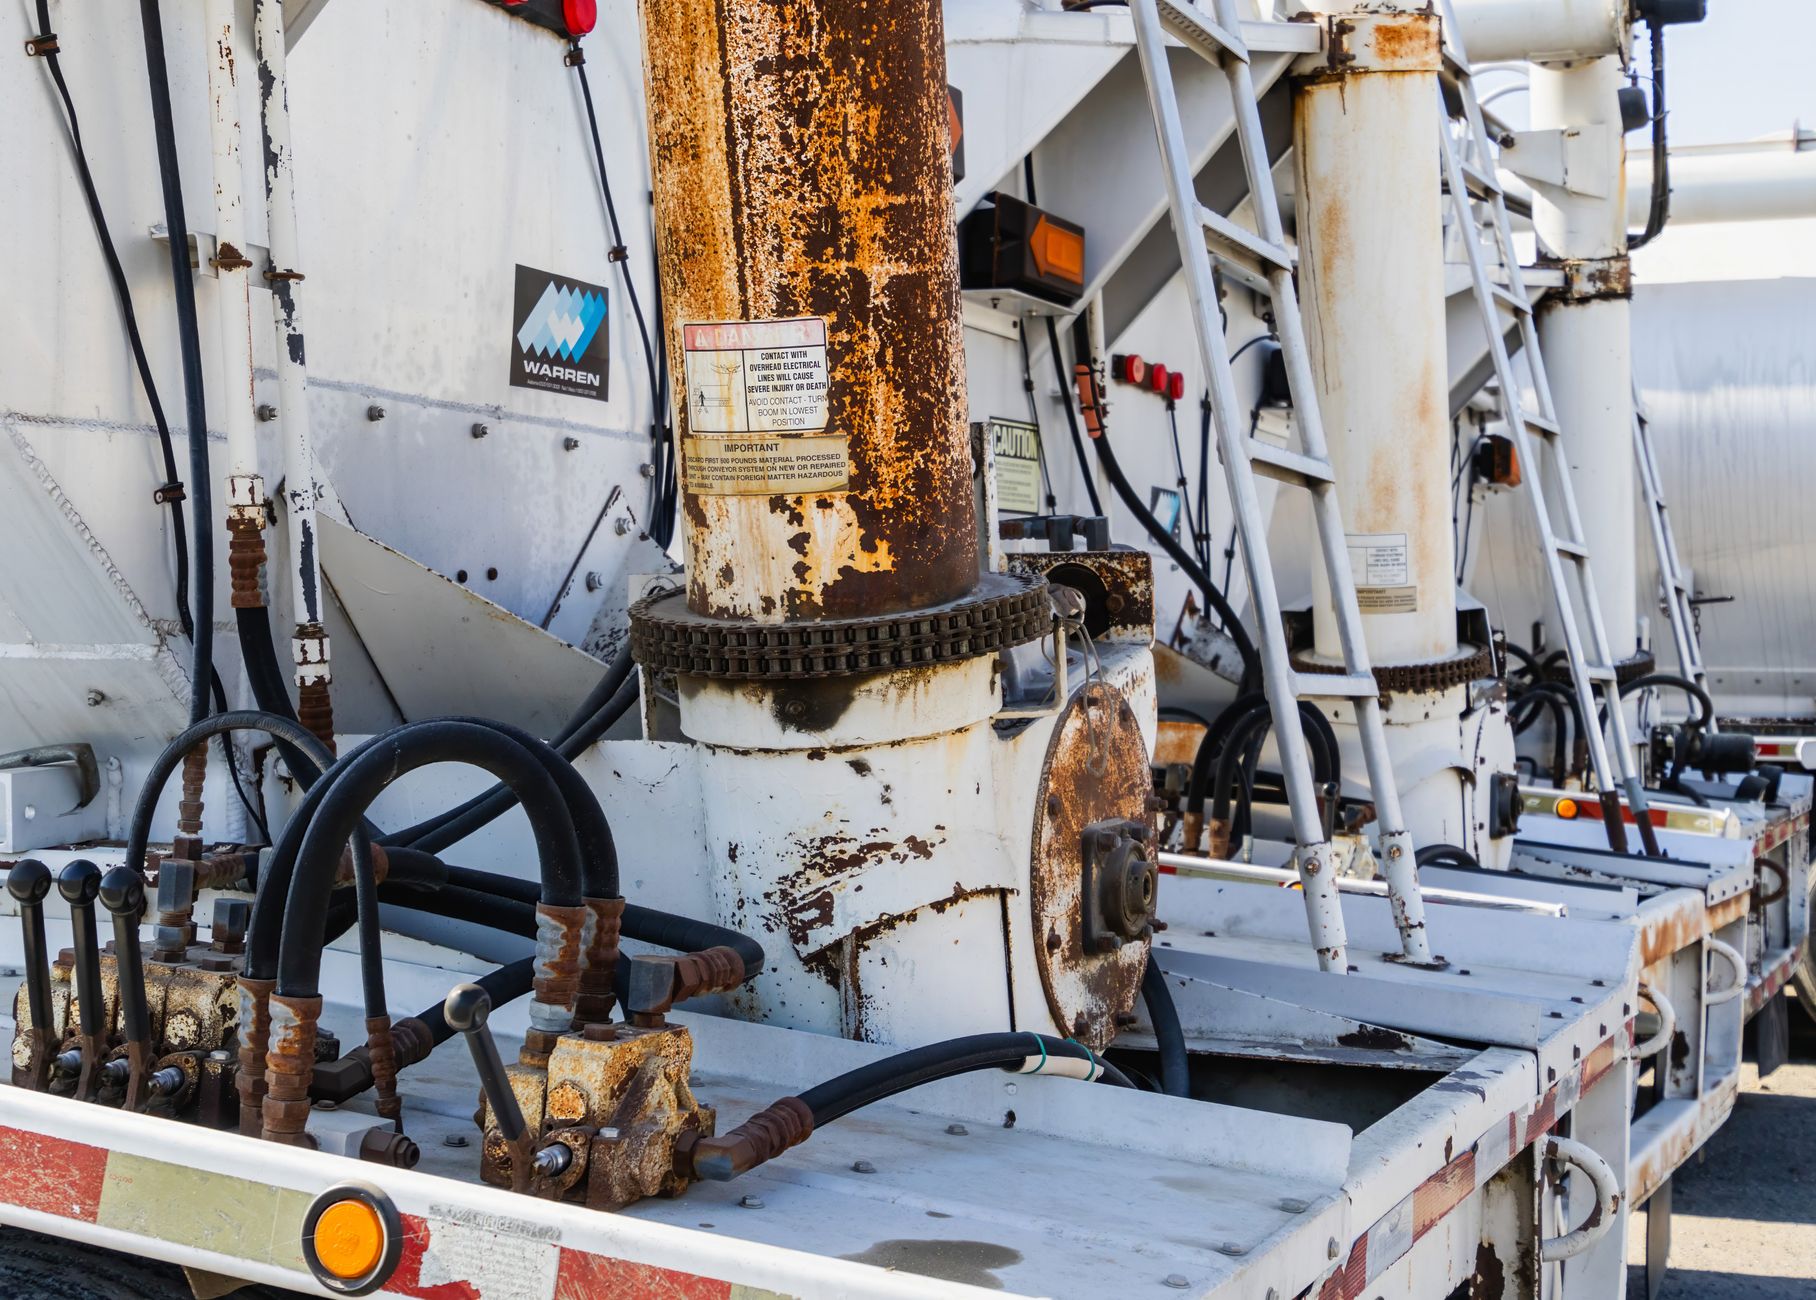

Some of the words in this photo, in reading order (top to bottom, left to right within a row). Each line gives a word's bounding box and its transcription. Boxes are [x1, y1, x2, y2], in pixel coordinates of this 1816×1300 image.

[761, 352, 789, 360] CONTACT
[790, 350, 808, 359] WITH
[749, 362, 782, 372] OVERHEAD
[783, 360, 821, 370] ELECTRICAL
[523, 360, 600, 387] WARREN
[757, 374, 775, 382] LINES
[776, 373, 791, 381] WILL
[793, 372, 814, 380] CAUSE
[748, 385, 770, 394] SEVERE
[771, 384, 794, 392] INJURY
[795, 383, 805, 391] OR
[806, 382, 827, 391] DEATH
[749, 397, 768, 406] AVOID
[769, 396, 802, 406] CONTACT
[808, 395, 827, 404] TURN
[758, 408, 779, 417] BOOM
[788, 406, 818, 415] LOWEST
[772, 418, 805, 426] POSITION
[993, 425, 1038, 459] CAUTION
[724, 443, 780, 453] IMPORTANT
[759, 456, 795, 464] MATERIAL
[796, 453, 841, 462] PROCESSED
[810, 461, 846, 470] REPAIRED
[797, 470, 843, 479] HAZARDOUS
